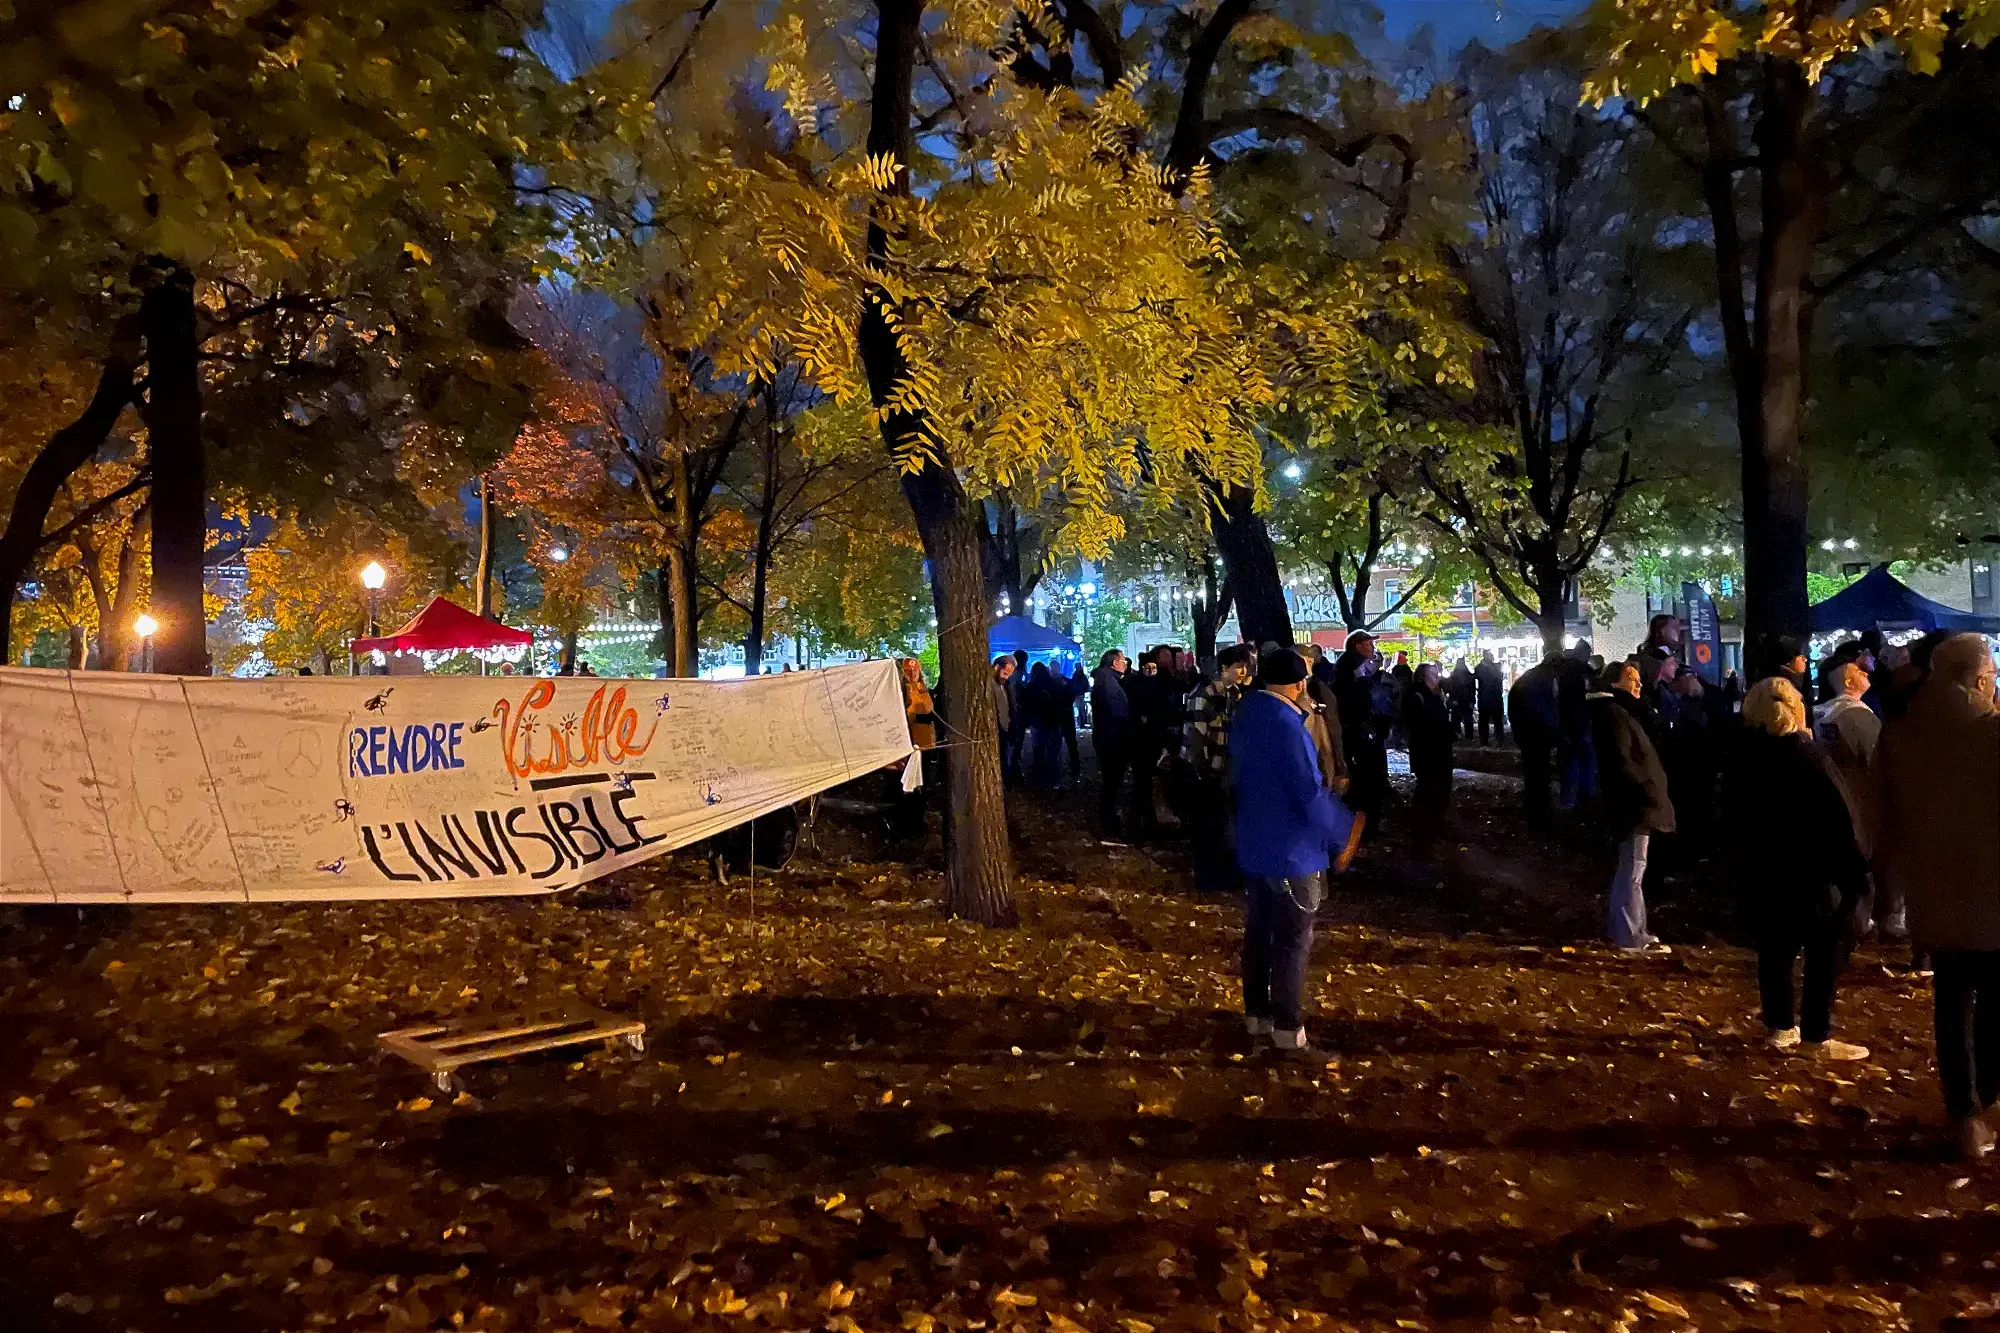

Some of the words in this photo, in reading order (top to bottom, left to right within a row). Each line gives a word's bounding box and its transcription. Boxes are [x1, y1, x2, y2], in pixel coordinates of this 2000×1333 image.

[350, 721, 465, 778] RENDRE
[493, 679, 658, 779] Visible
[361, 788, 668, 882] L'INVISIBLE
